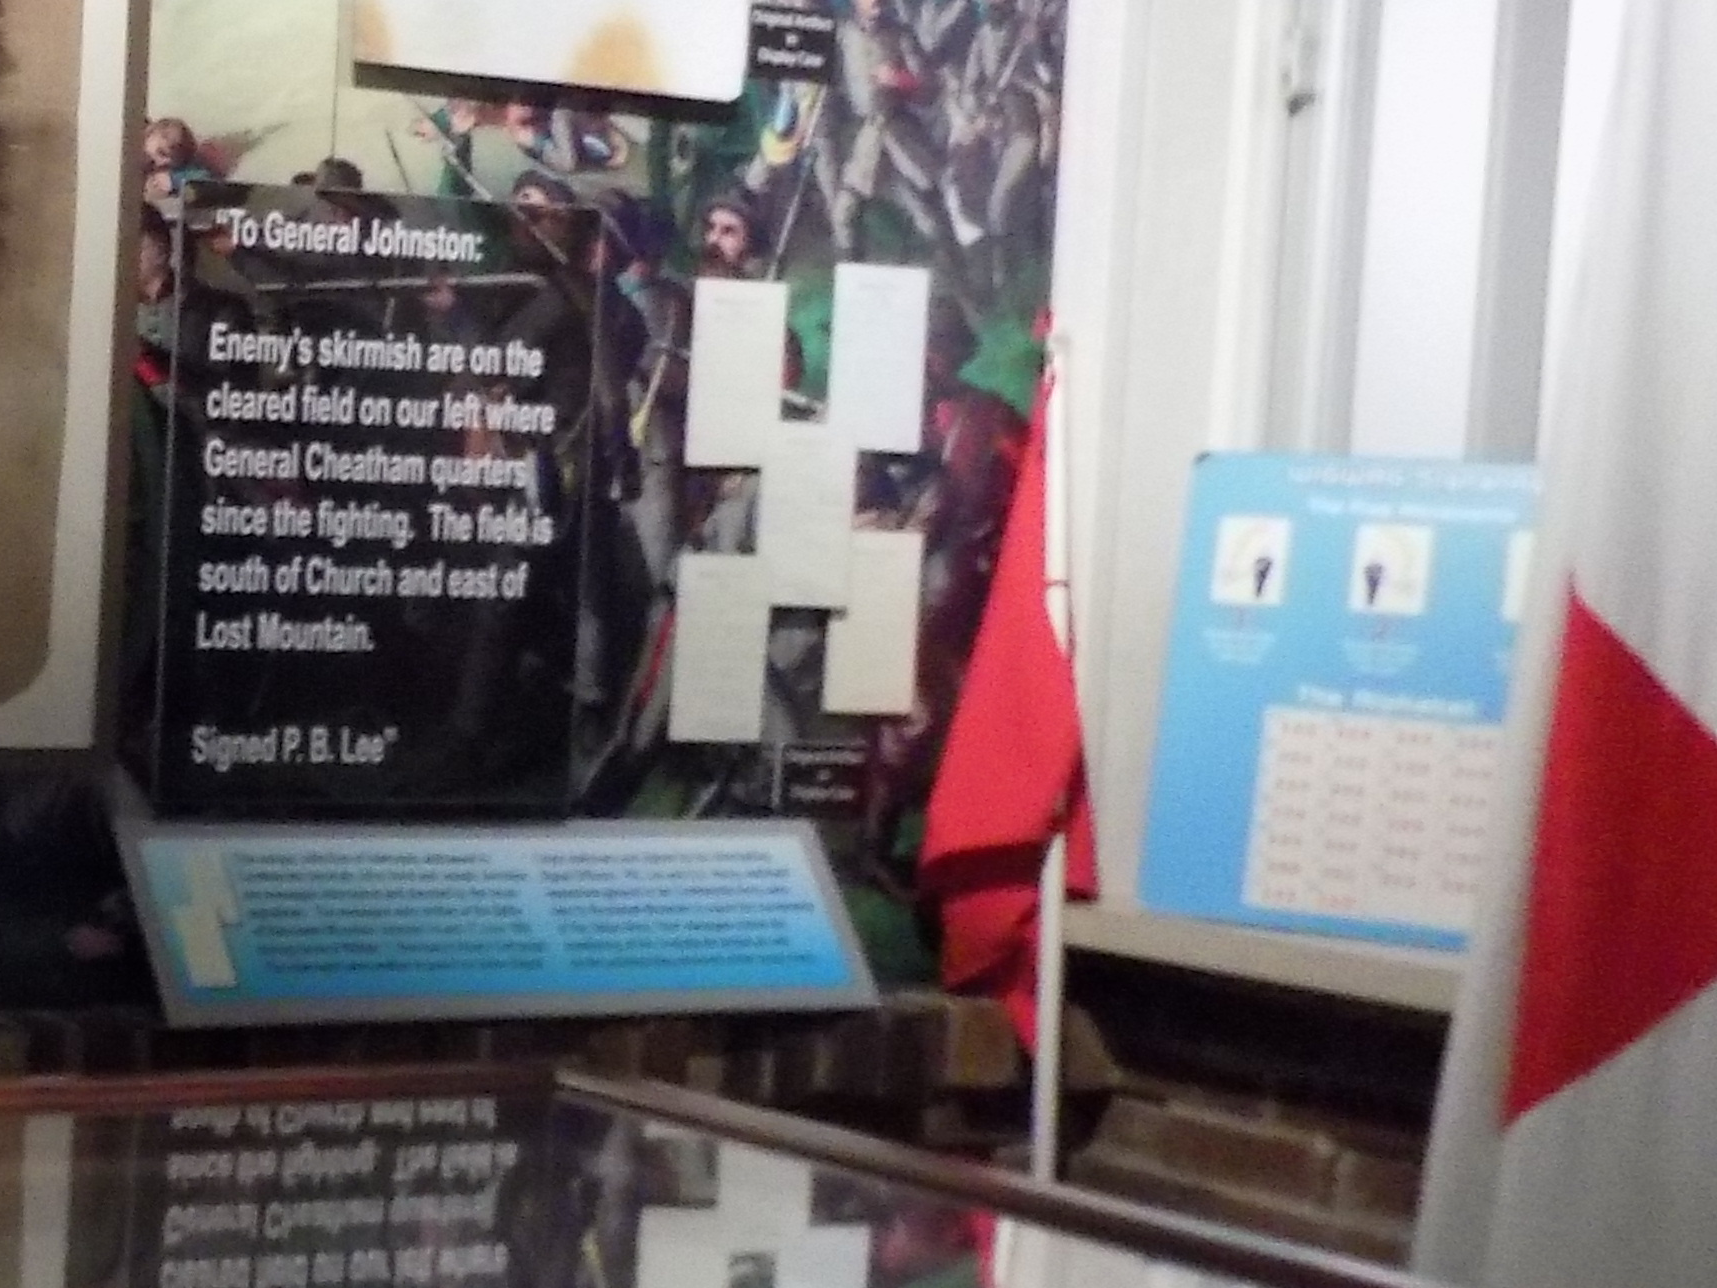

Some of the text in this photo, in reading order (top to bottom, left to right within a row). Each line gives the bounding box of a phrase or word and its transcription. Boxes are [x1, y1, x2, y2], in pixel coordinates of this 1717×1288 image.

[265, 211, 359, 252] General
[365, 214, 483, 260] Johnston:
[210, 323, 544, 378] Enemy's skirmish are on the
[207, 383, 555, 434] cleared field on our left where
[204, 438, 298, 478] General
[304, 442, 424, 484] Cheatham
[201, 500, 553, 547] since the fighting. The field is
[199, 557, 529, 600] south of Church and east of
[197, 613, 375, 652] Lost Mountain.
[192, 726, 274, 770] Signed
[282, 727, 303, 763] P.
[341, 727, 398, 765] Lee"
